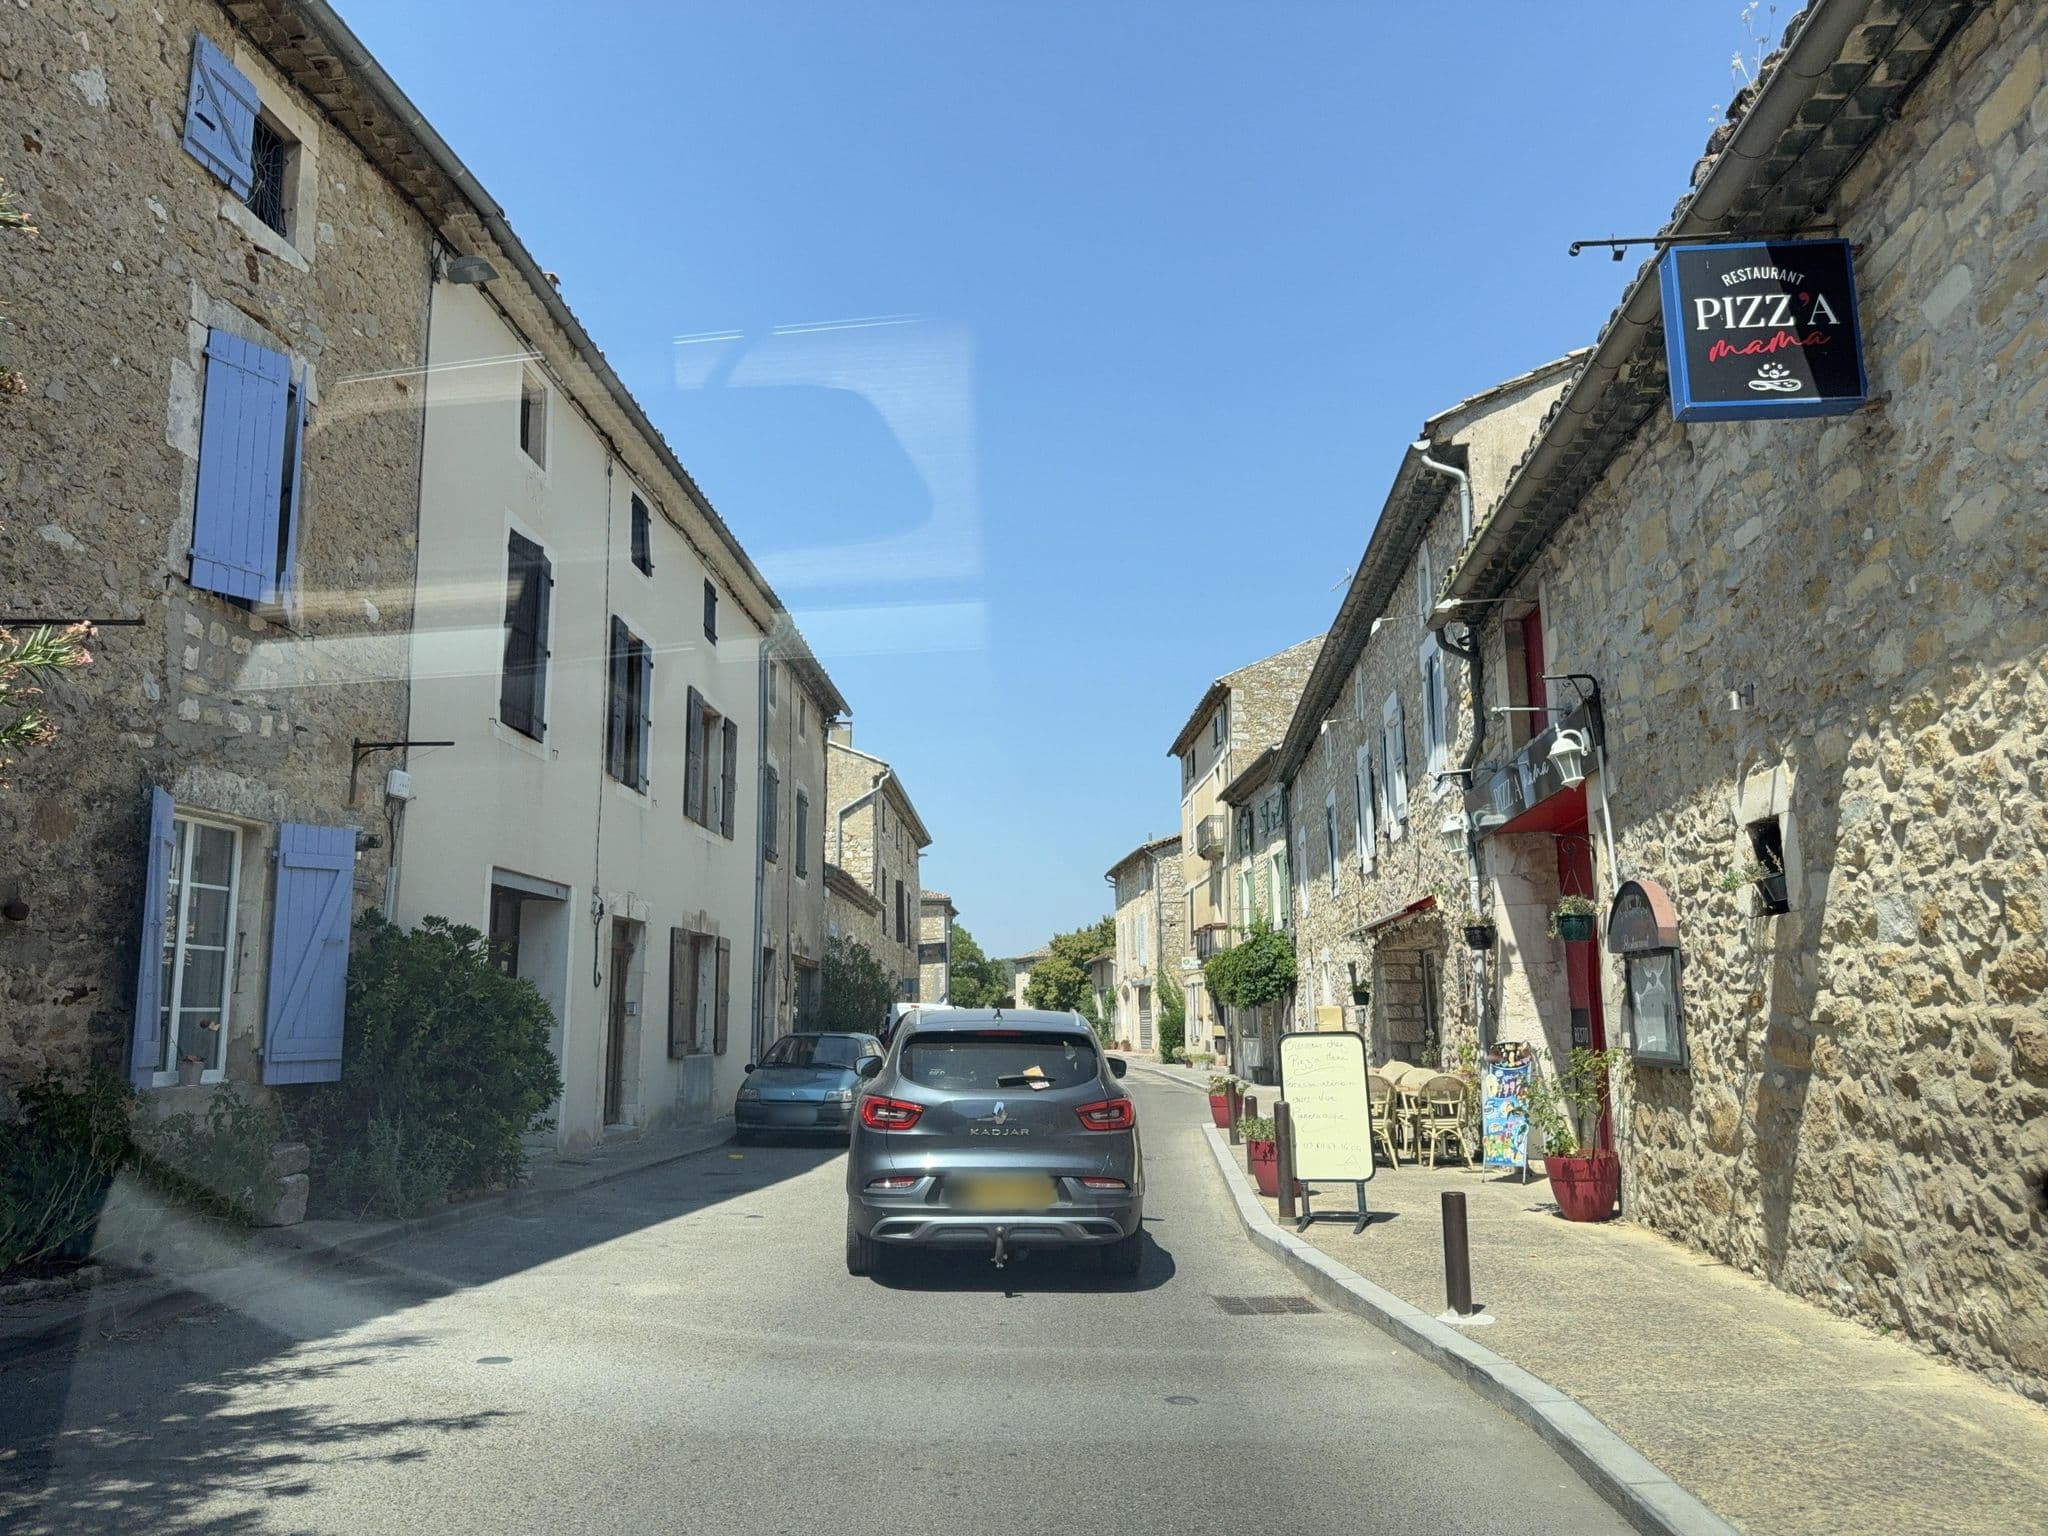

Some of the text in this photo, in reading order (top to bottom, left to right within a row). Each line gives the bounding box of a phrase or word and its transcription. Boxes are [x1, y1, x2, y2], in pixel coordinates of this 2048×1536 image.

[1721, 266, 1804, 287] RESTAURANT
[1708, 330, 1831, 363] mama
[970, 1128, 1030, 1136] KADJAR
